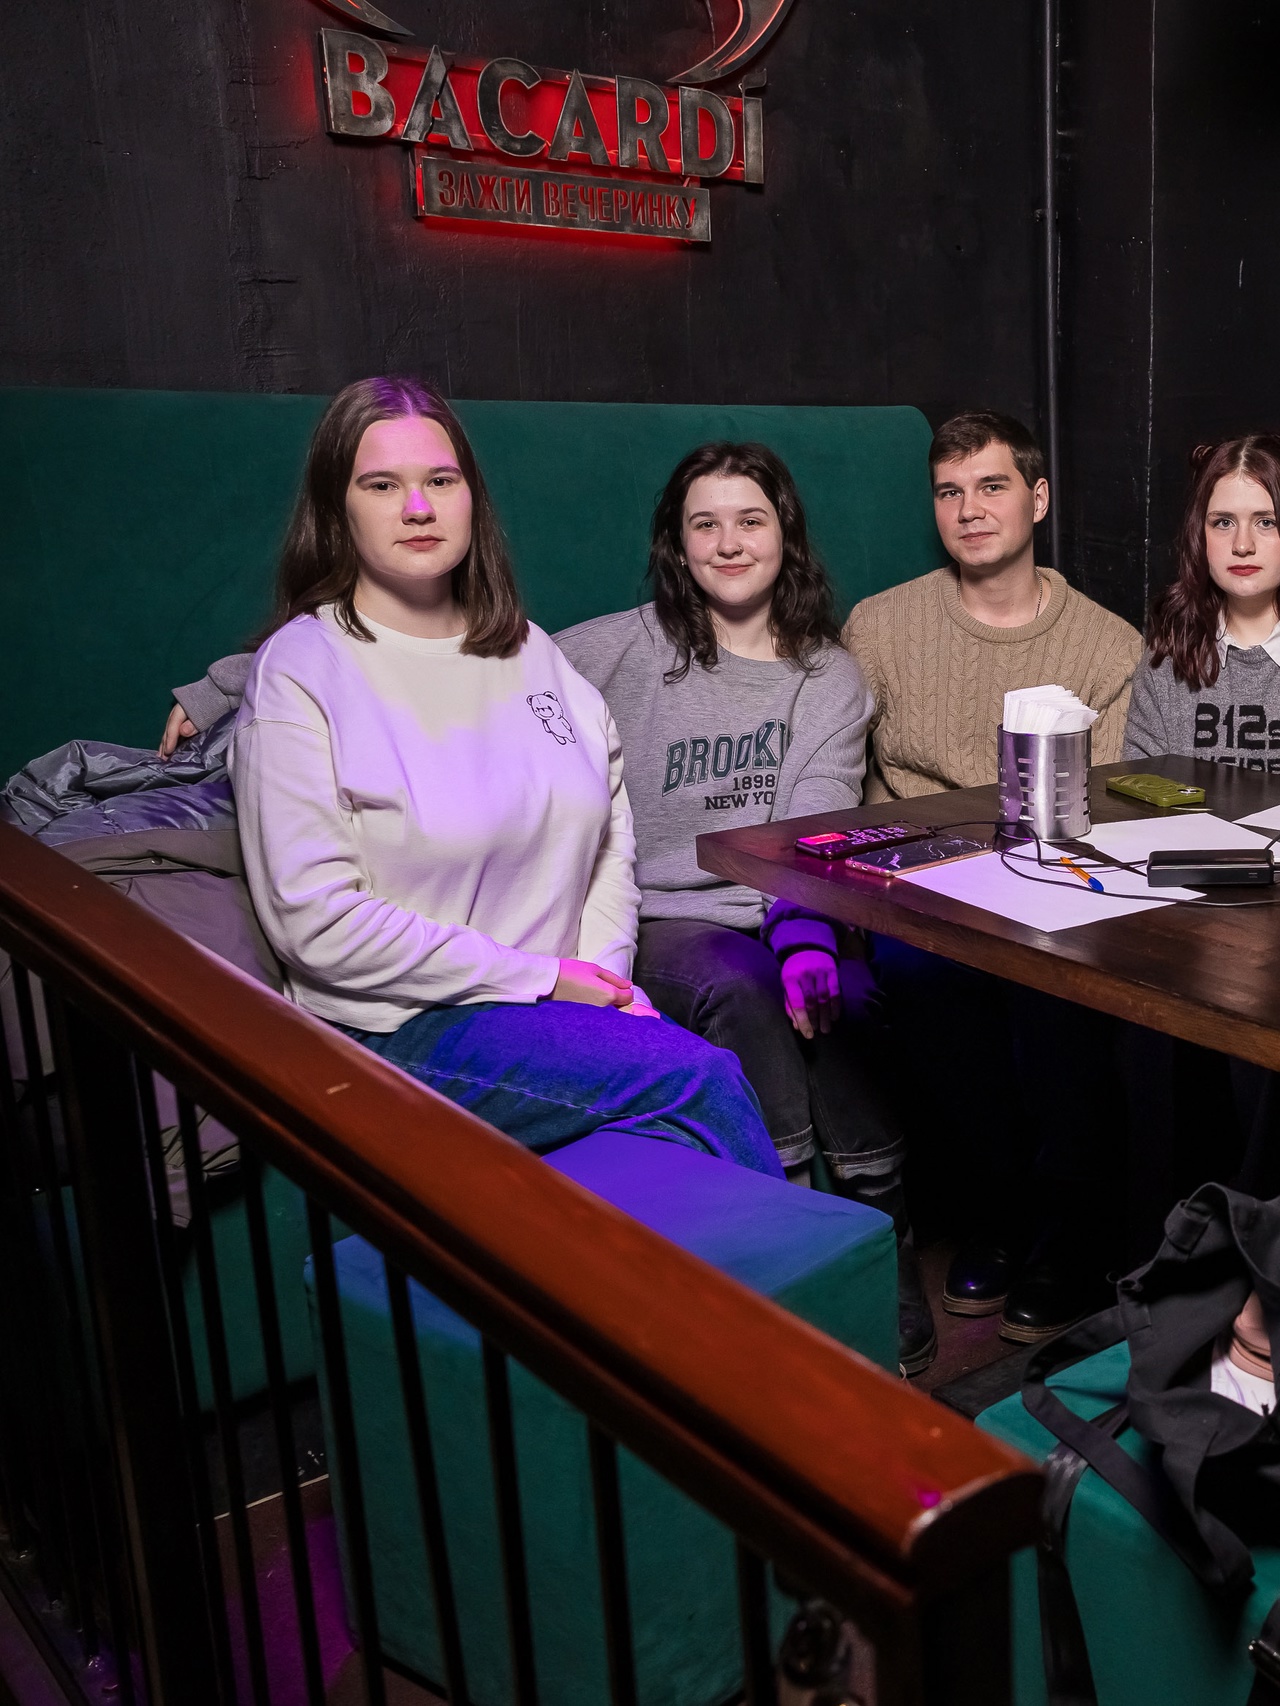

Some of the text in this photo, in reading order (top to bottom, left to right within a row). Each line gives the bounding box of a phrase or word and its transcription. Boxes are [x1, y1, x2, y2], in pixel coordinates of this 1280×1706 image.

[437, 169, 698, 230] ЗАЖГИ ВЕЧЕРИНКУ
[661, 718, 793, 798] BROOK
[704, 790, 776, 810] NEW YO
[732, 773, 776, 792] 1898
